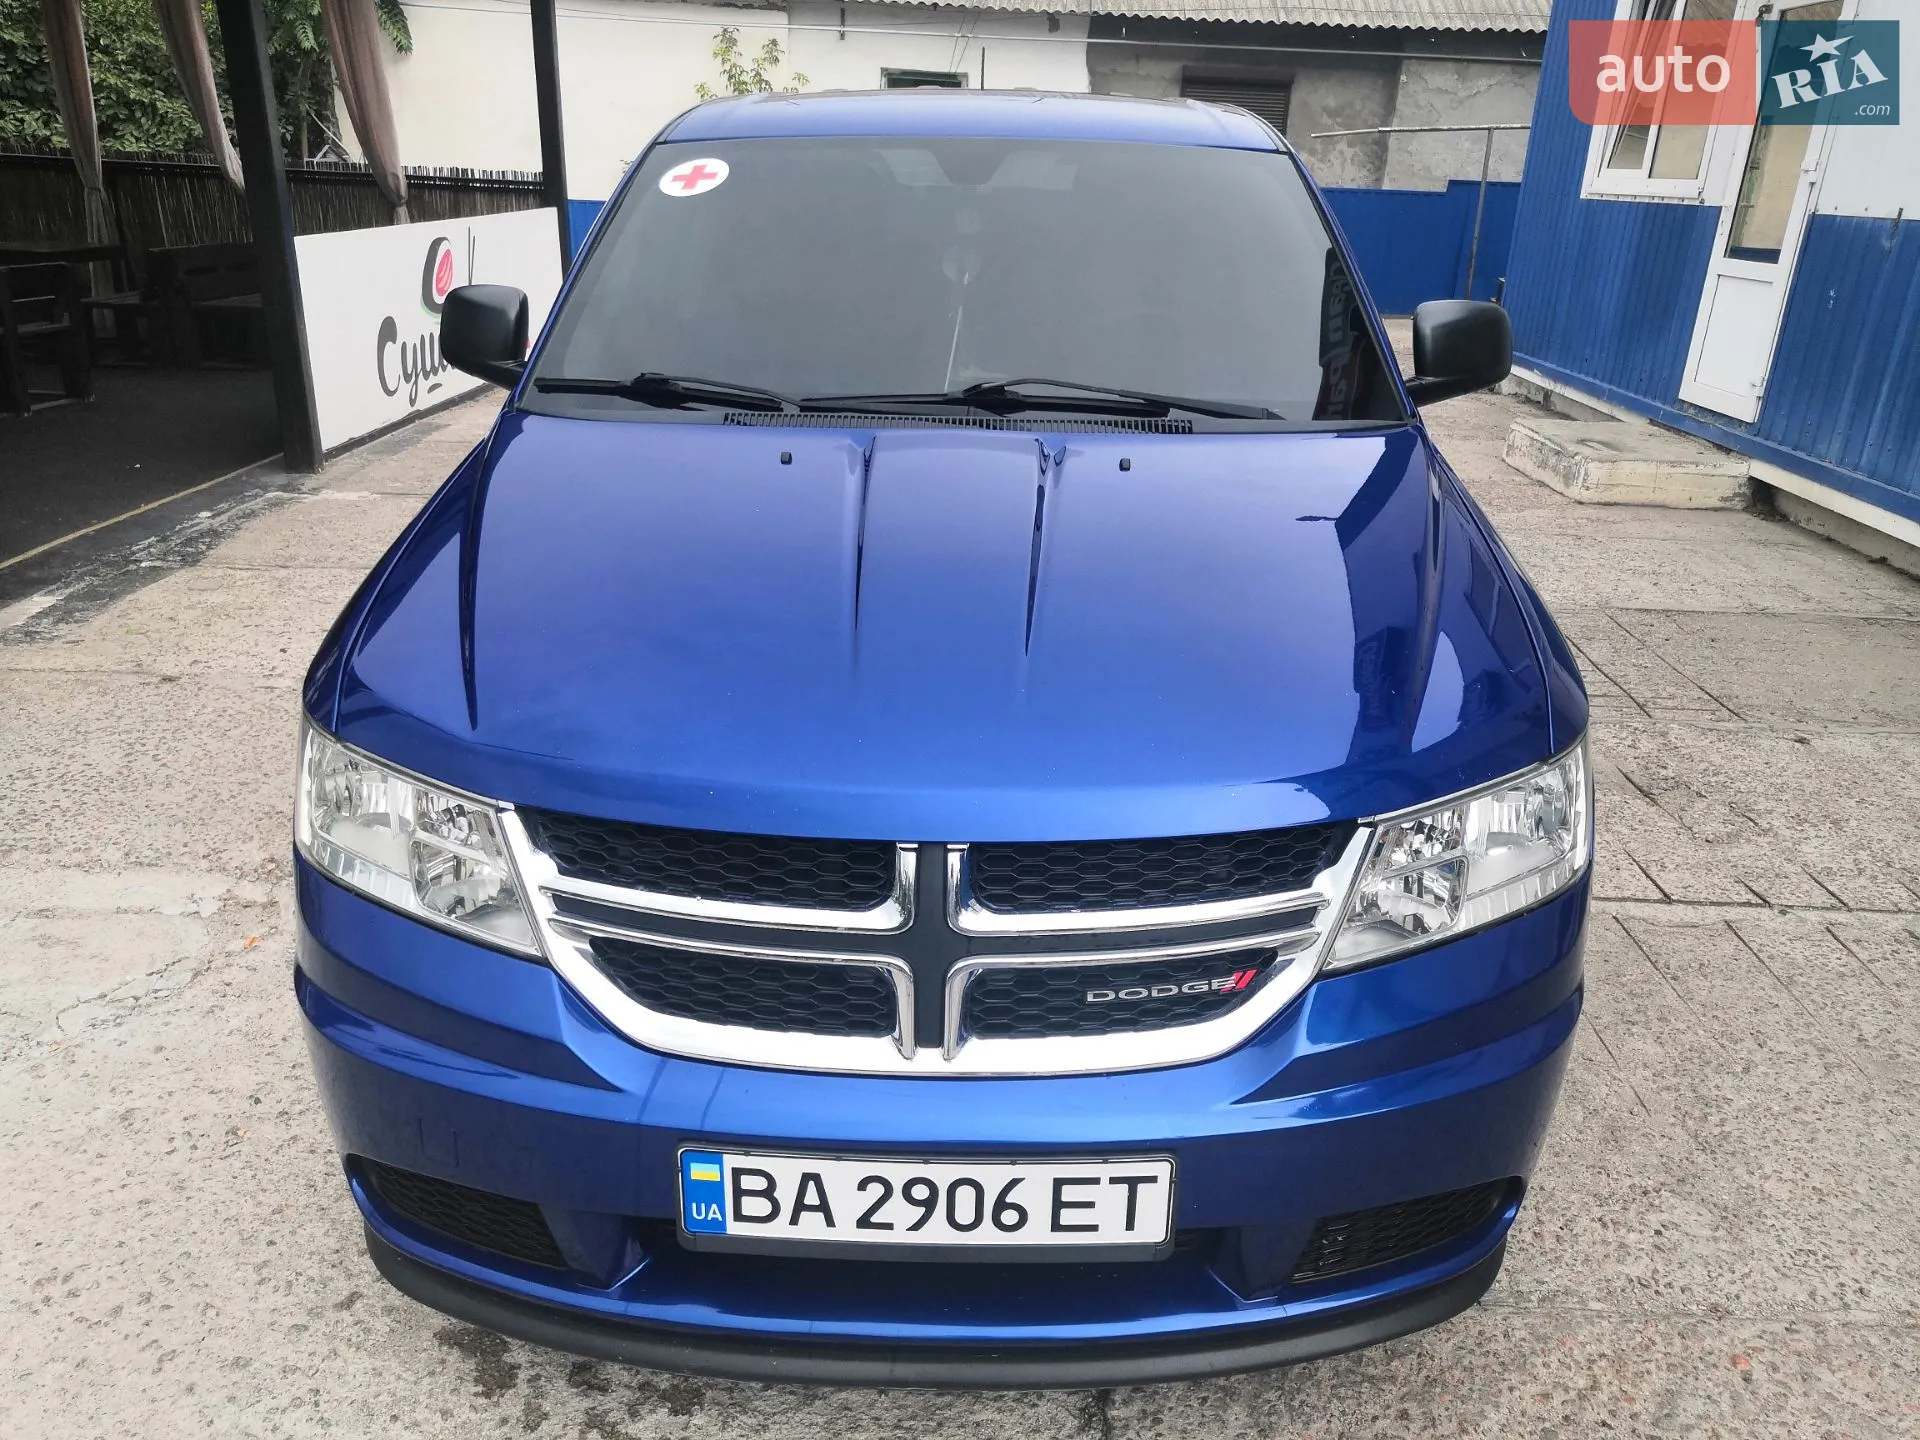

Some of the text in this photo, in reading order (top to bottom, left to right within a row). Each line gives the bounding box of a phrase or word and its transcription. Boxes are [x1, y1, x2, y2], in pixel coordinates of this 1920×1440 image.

[377, 316, 457, 407] Суш
[1086, 976, 1236, 1002] DODGE
[692, 1202, 723, 1222] UA
[731, 1166, 1159, 1233] BA 2906 ET
